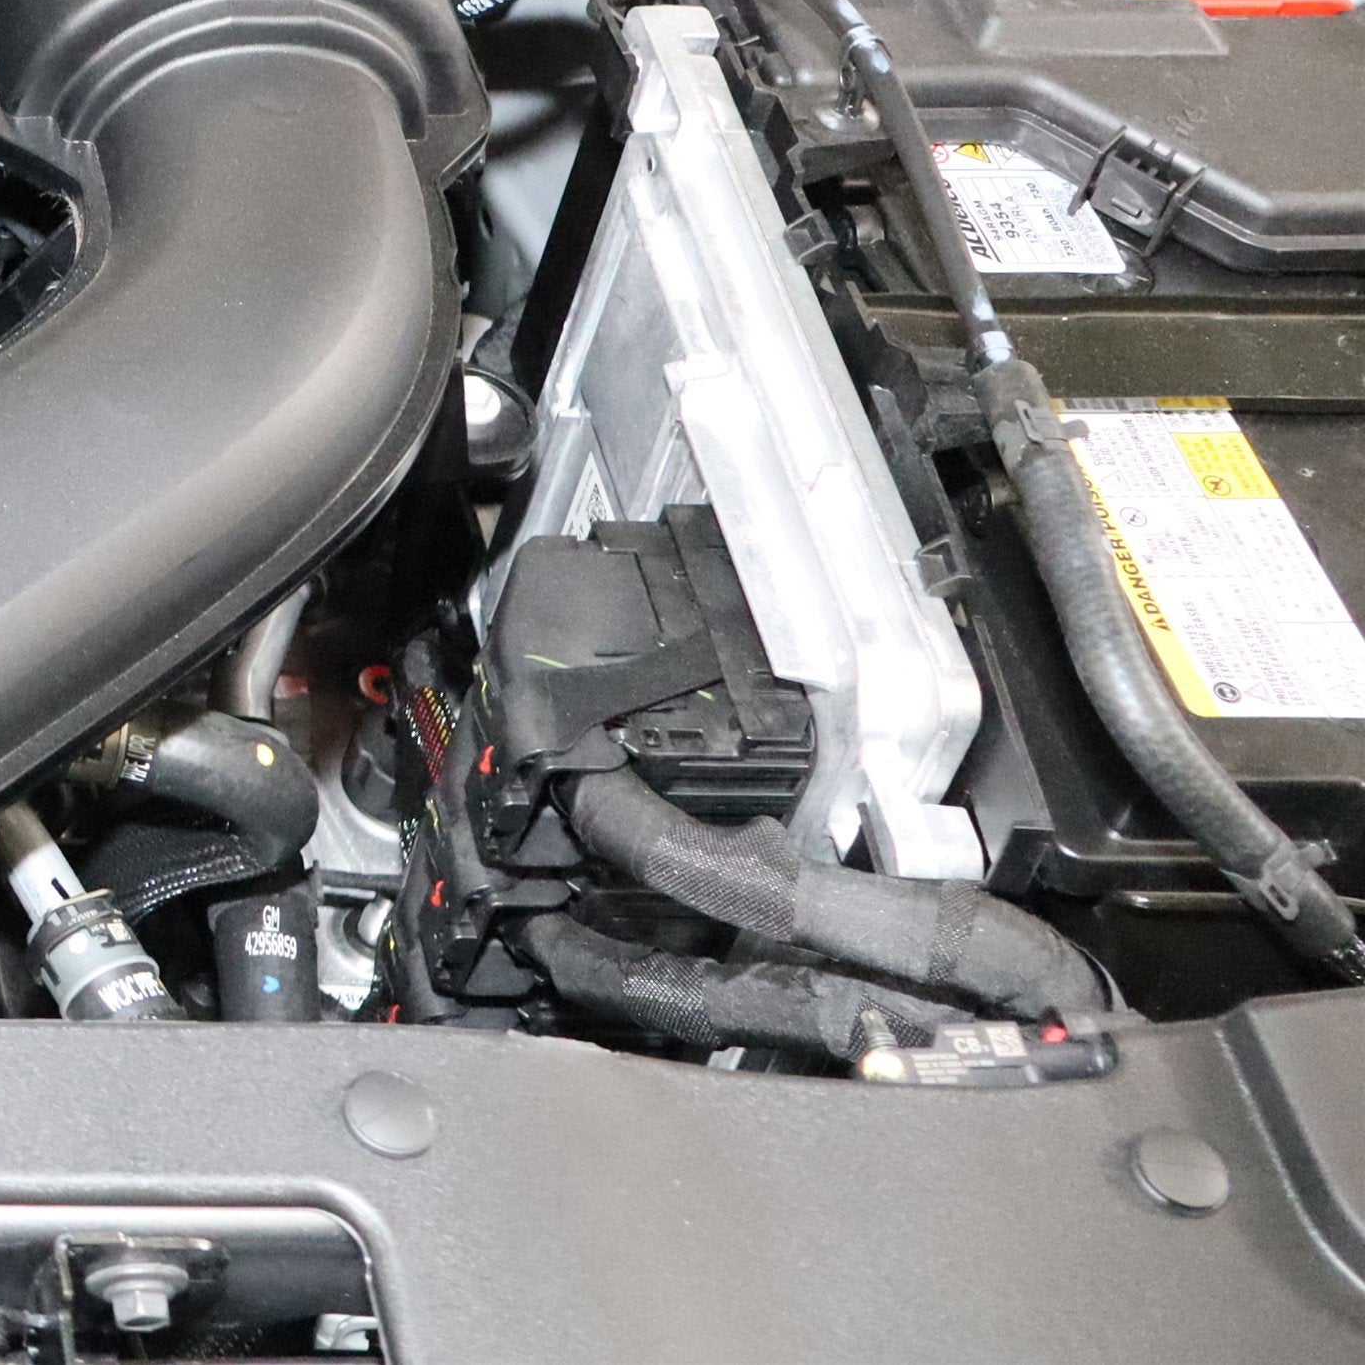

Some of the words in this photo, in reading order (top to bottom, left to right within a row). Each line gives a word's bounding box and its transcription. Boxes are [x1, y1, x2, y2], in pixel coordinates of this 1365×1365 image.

[1026, 182, 1043, 199] 730
[988, 202, 1020, 238] 9354
[1059, 239, 1076, 255] 730
[127, 735, 156, 760] UPR
[263, 905, 280, 931] GM
